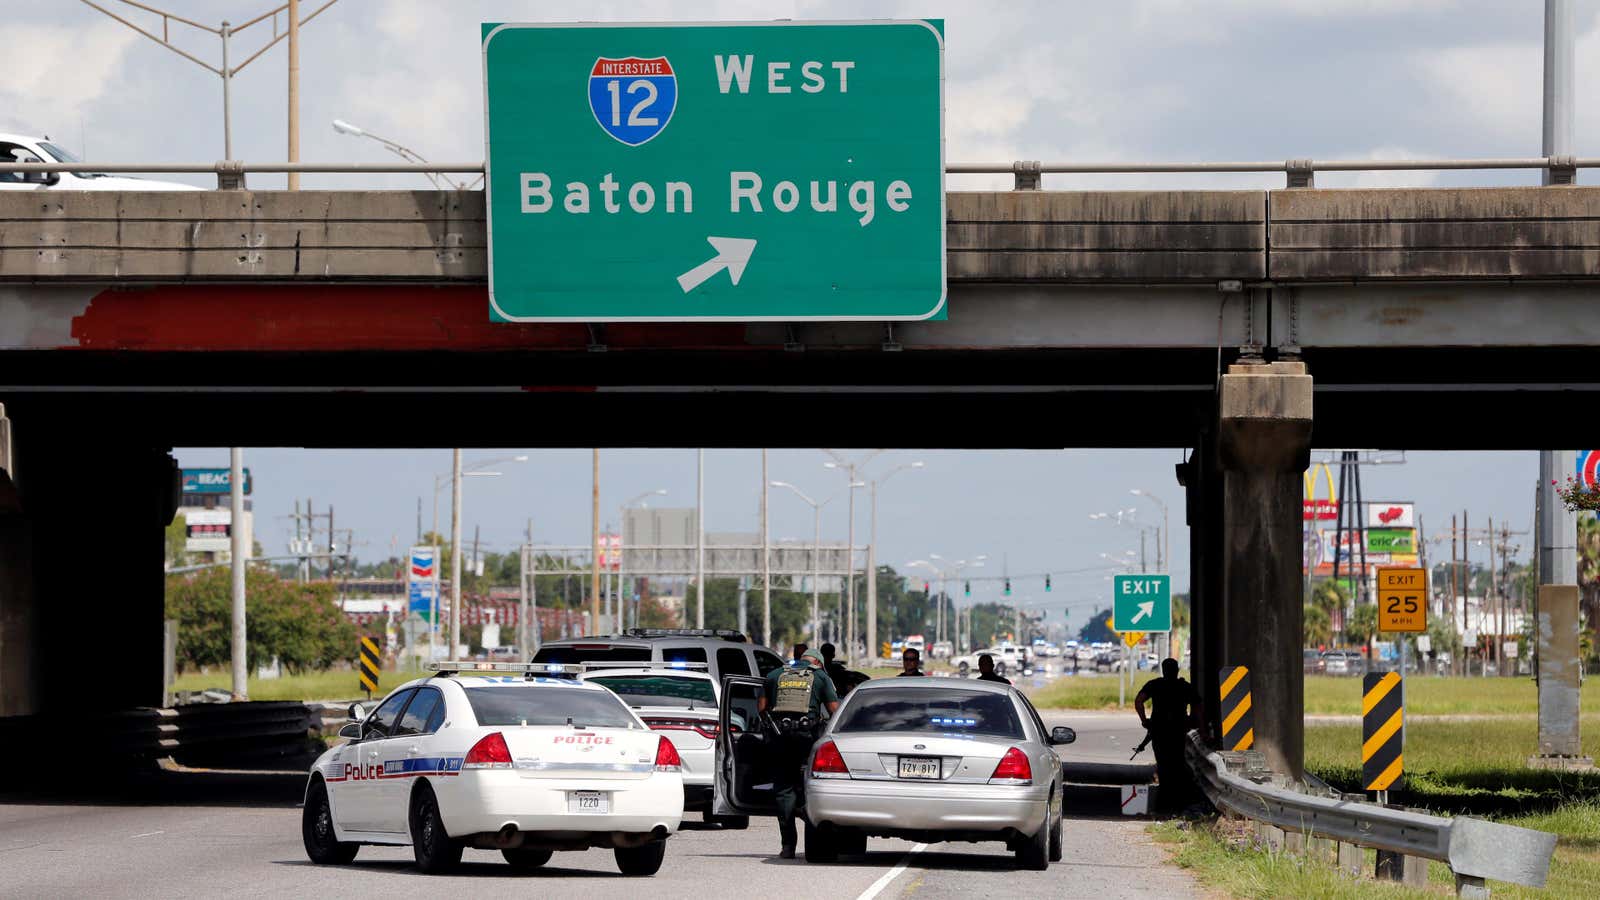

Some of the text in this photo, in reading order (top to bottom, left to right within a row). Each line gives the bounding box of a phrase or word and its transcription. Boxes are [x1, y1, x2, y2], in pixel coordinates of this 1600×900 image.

[602, 63, 662, 74] INTERSTATE
[714, 54, 856, 94] WEST
[607, 79, 659, 126] 12
[520, 171, 913, 227] Baton Rouge
[1388, 575, 1415, 585] EXIT
[1122, 580, 1161, 594] EXIT
[1387, 596, 1418, 613] 25
[1391, 617, 1413, 625] MPH
[553, 735, 615, 745] POLICE
[921, 764, 937, 774] 817
[579, 797, 599, 808] 1220
